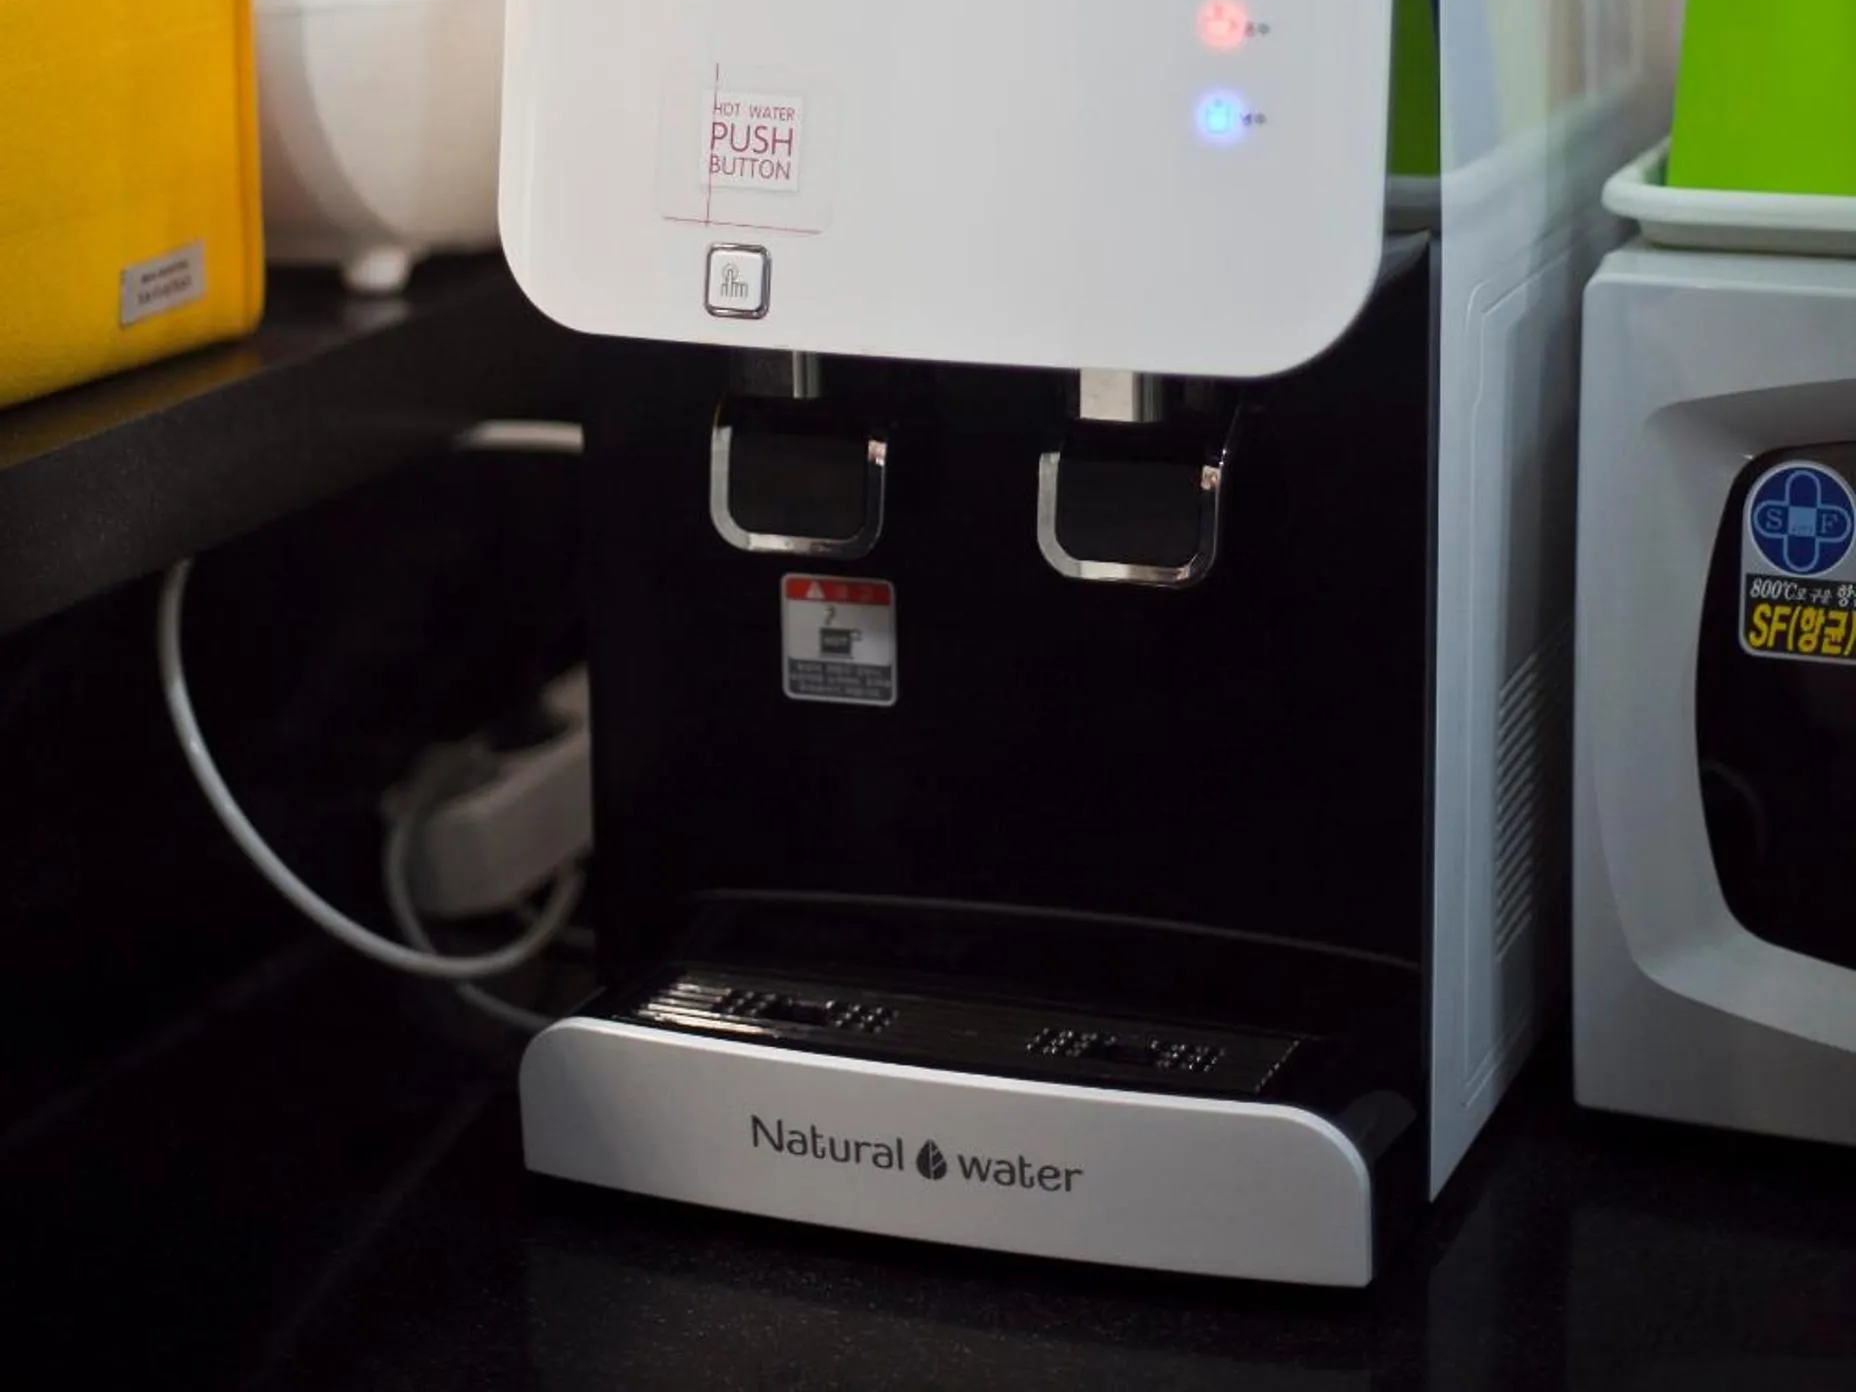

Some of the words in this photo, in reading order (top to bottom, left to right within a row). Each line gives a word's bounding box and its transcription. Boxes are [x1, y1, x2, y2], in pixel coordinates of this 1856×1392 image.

[713, 102, 741, 117] HOT
[750, 105, 795, 121] WATER
[710, 121, 793, 156] PUSH
[710, 155, 791, 180] BUTTON
[751, 1114, 904, 1171] Natural
[957, 1153, 1083, 1192] water
